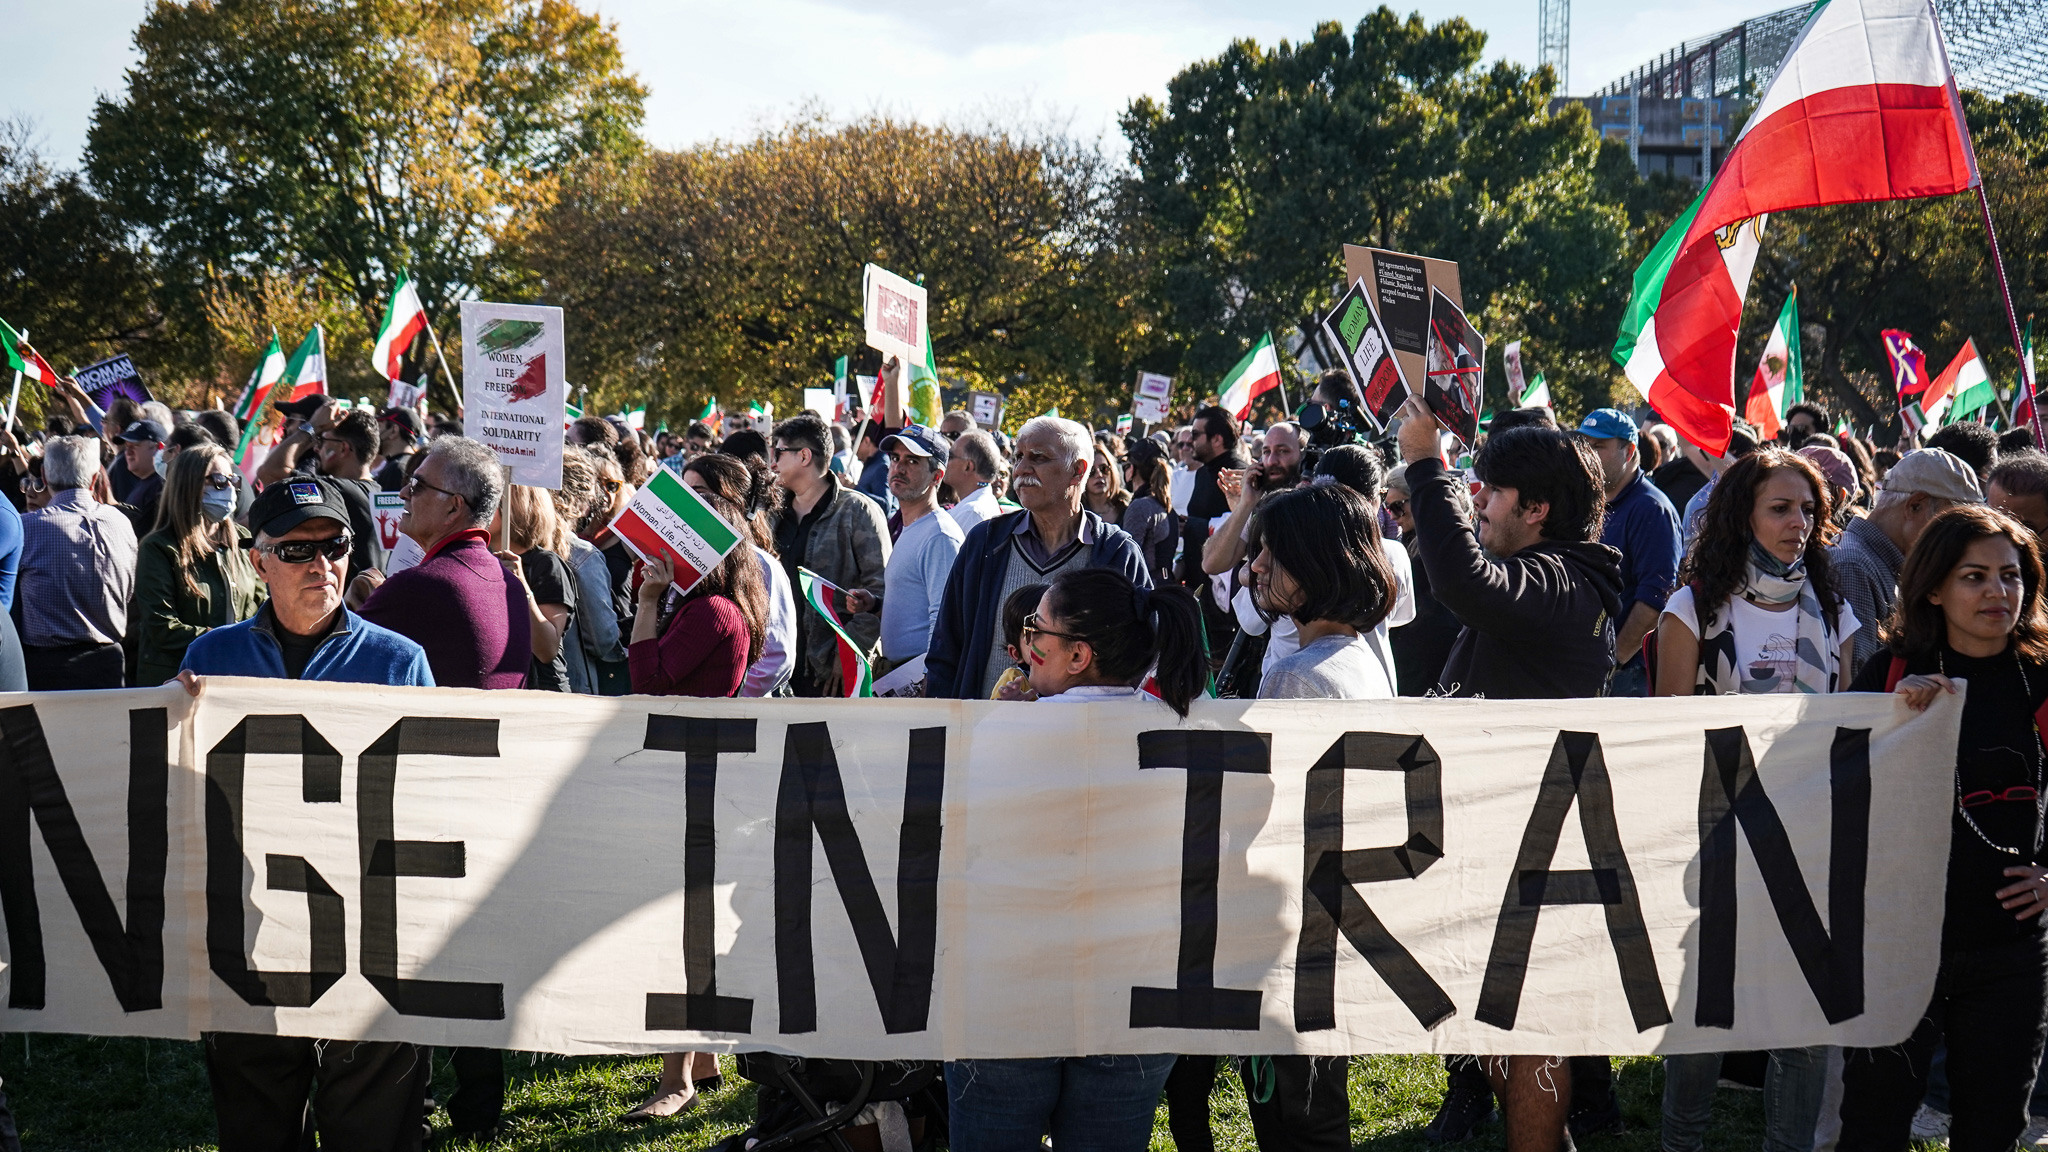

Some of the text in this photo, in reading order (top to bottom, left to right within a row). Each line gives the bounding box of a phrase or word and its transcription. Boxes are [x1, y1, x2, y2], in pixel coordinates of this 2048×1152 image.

[1406, 265, 1422, 274] between
[1381, 288, 1396, 296] accepted
[1397, 289, 1406, 298] from
[1344, 302, 1364, 342] WOMAN
[487, 352, 522, 363] WOMEN
[1360, 338, 1377, 367] LIFE
[76, 358, 136, 387] WOMAN
[496, 368, 515, 378] LIFE
[485, 381, 527, 394] FREEDOM
[1370, 361, 1394, 408] FREEDOM
[481, 410, 546, 425] INTERNATIONAL
[482, 427, 541, 442] SOLIDARITY
[633, 500, 708, 572] Woman, Life, Freedom
[643, 713, 946, 1034] IN
[1129, 725, 1872, 1034] IRAN
